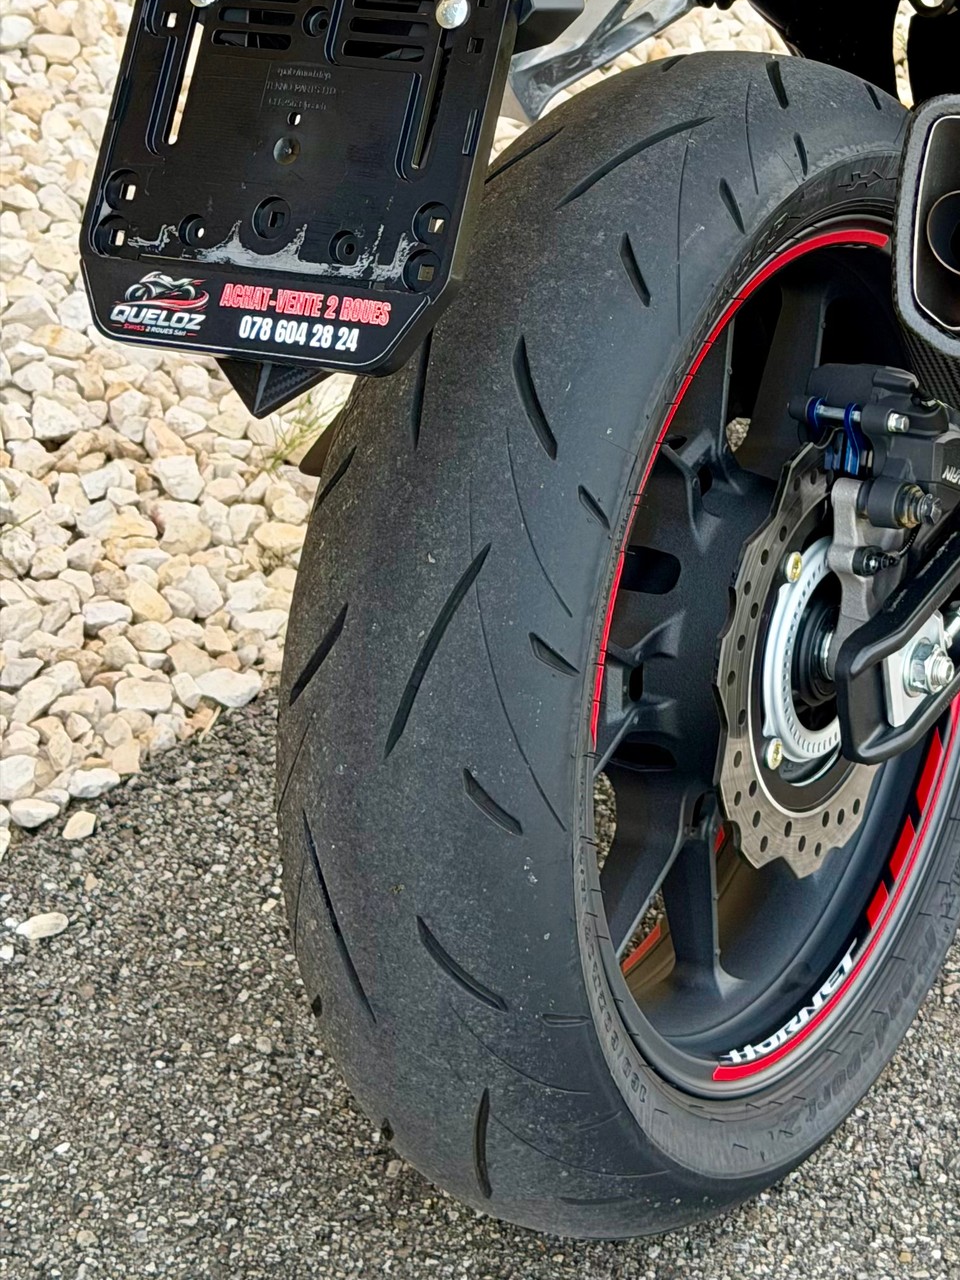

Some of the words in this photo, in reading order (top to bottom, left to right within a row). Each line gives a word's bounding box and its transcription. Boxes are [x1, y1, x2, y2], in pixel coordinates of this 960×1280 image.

[110, 305, 206, 330] QUELOZ
[219, 283, 325, 318] ACHAT-VENTE
[324, 295, 339, 319] 2
[339, 297, 392, 326] ROUES
[150, 326, 174, 334] ROUES
[238, 315, 273, 341] 078
[274, 319, 309, 346] 604
[309, 323, 334, 349] 28
[335, 327, 360, 352] 24
[719, 936, 858, 1064] HORNET
